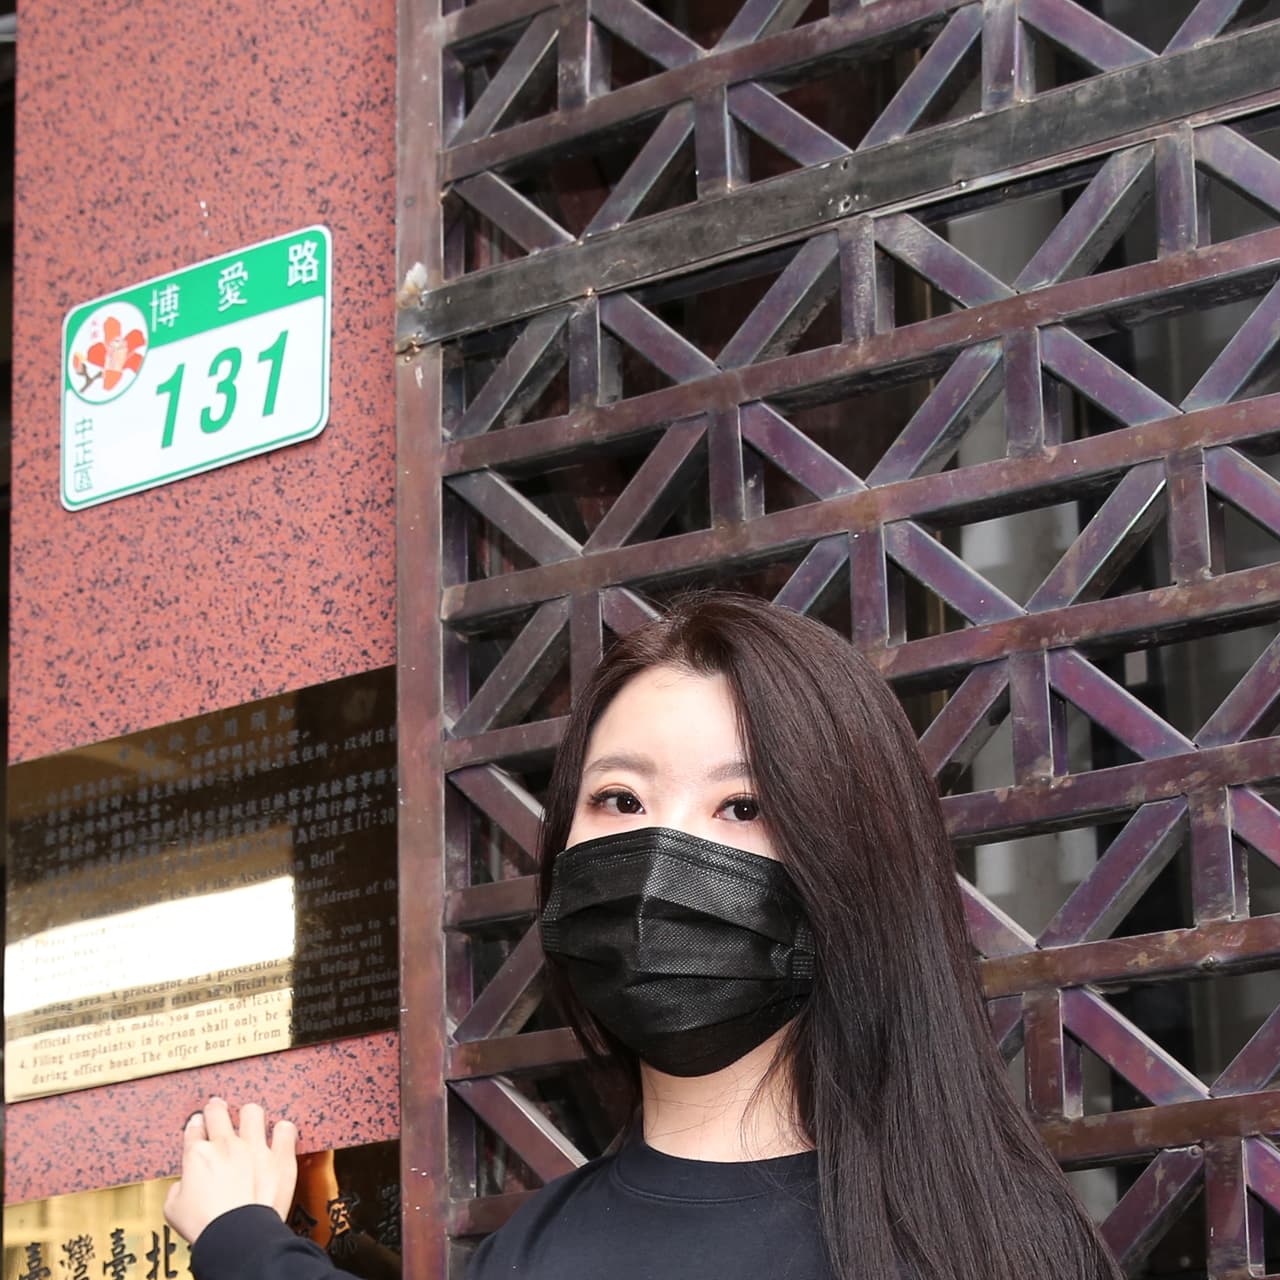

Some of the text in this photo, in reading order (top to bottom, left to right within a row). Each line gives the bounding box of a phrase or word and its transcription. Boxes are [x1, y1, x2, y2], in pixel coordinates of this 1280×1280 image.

[149, 240, 320, 333] 博愛路
[156, 330, 289, 449] 131
[310, 850, 335, 869] Bell
[383, 876, 397, 891] th
[340, 924, 362, 939] you
[122, 982, 181, 1001] prosecutor
[226, 975, 266, 994] official
[76, 1026, 112, 1042] record
[195, 1005, 222, 1018] must
[338, 968, 397, 993] permissio
[158, 1028, 196, 1046] person
[201, 1019, 227, 1034] shall
[233, 1016, 257, 1027] only
[264, 1011, 278, 1021] be
[32, 1072, 67, 1083] during
[73, 1065, 104, 1077] office
[141, 1051, 161, 1063] The
[204, 1039, 232, 1051] hour
[253, 1030, 280, 1041] from
